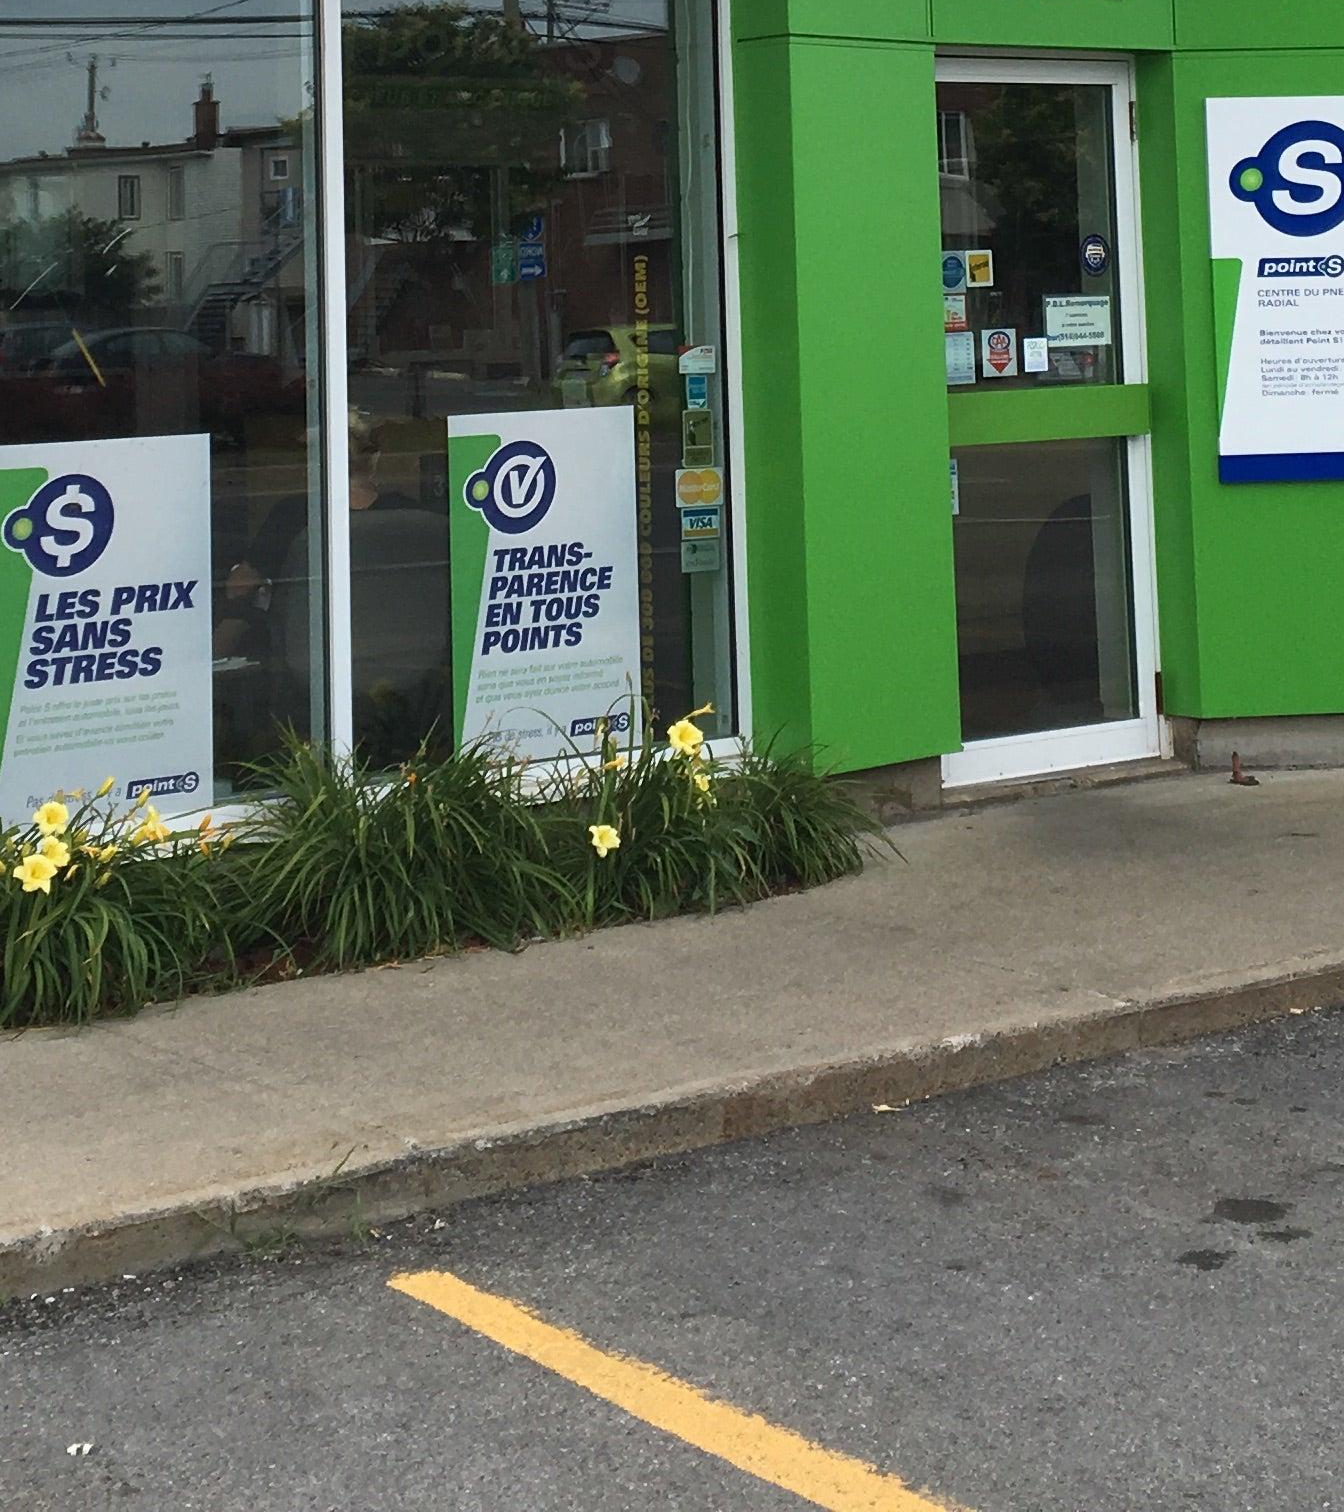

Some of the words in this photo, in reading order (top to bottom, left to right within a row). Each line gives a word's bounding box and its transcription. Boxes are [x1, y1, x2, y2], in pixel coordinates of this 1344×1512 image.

[1272, 140, 1343, 215] S
[634, 255, 649, 315] (OEM)
[1263, 258, 1316, 277] point
[1257, 289, 1300, 297] CENTRE
[1303, 288, 1319, 296] DU
[1258, 299, 1299, 307] RADIAL
[635, 321, 650, 425] D'ORIGINE
[637, 431, 652, 536] COULEURS
[689, 516, 713, 529] VISA
[493, 541, 593, 573] TRANS-
[488, 566, 613, 601] PARENCE
[34, 588, 100, 624] LES
[110, 580, 199, 616] PRIX
[485, 601, 522, 628] EN
[530, 593, 601, 624] TOUS
[29, 618, 133, 656] SANS
[481, 622, 583, 656] POINTS
[24, 646, 163, 690] STRESS
